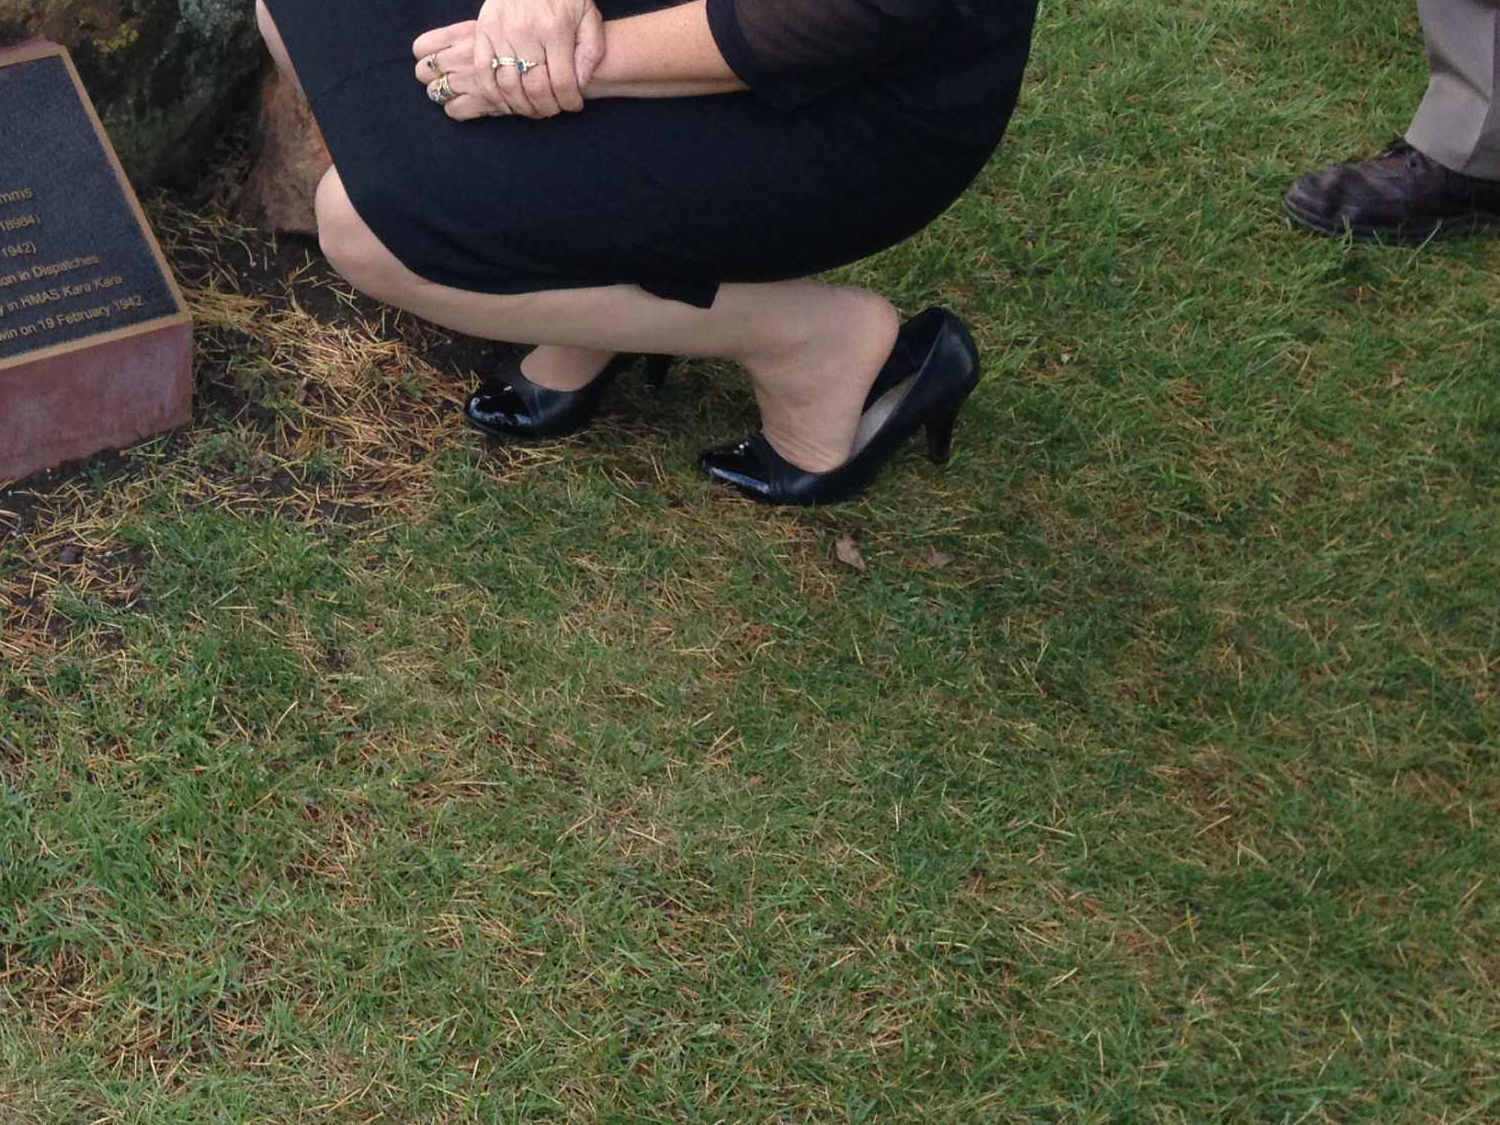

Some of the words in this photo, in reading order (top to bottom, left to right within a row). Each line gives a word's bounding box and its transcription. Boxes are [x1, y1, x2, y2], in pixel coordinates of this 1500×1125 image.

[2, 241, 37, 257] 1942)
[19, 270, 31, 282] in
[6, 299, 20, 312] in
[20, 288, 60, 308] HMAS
[62, 282, 92, 297] Kara
[93, 275, 123, 290] Kara
[19, 324, 37, 336] on
[37, 316, 54, 330] 19
[55, 304, 112, 327] February
